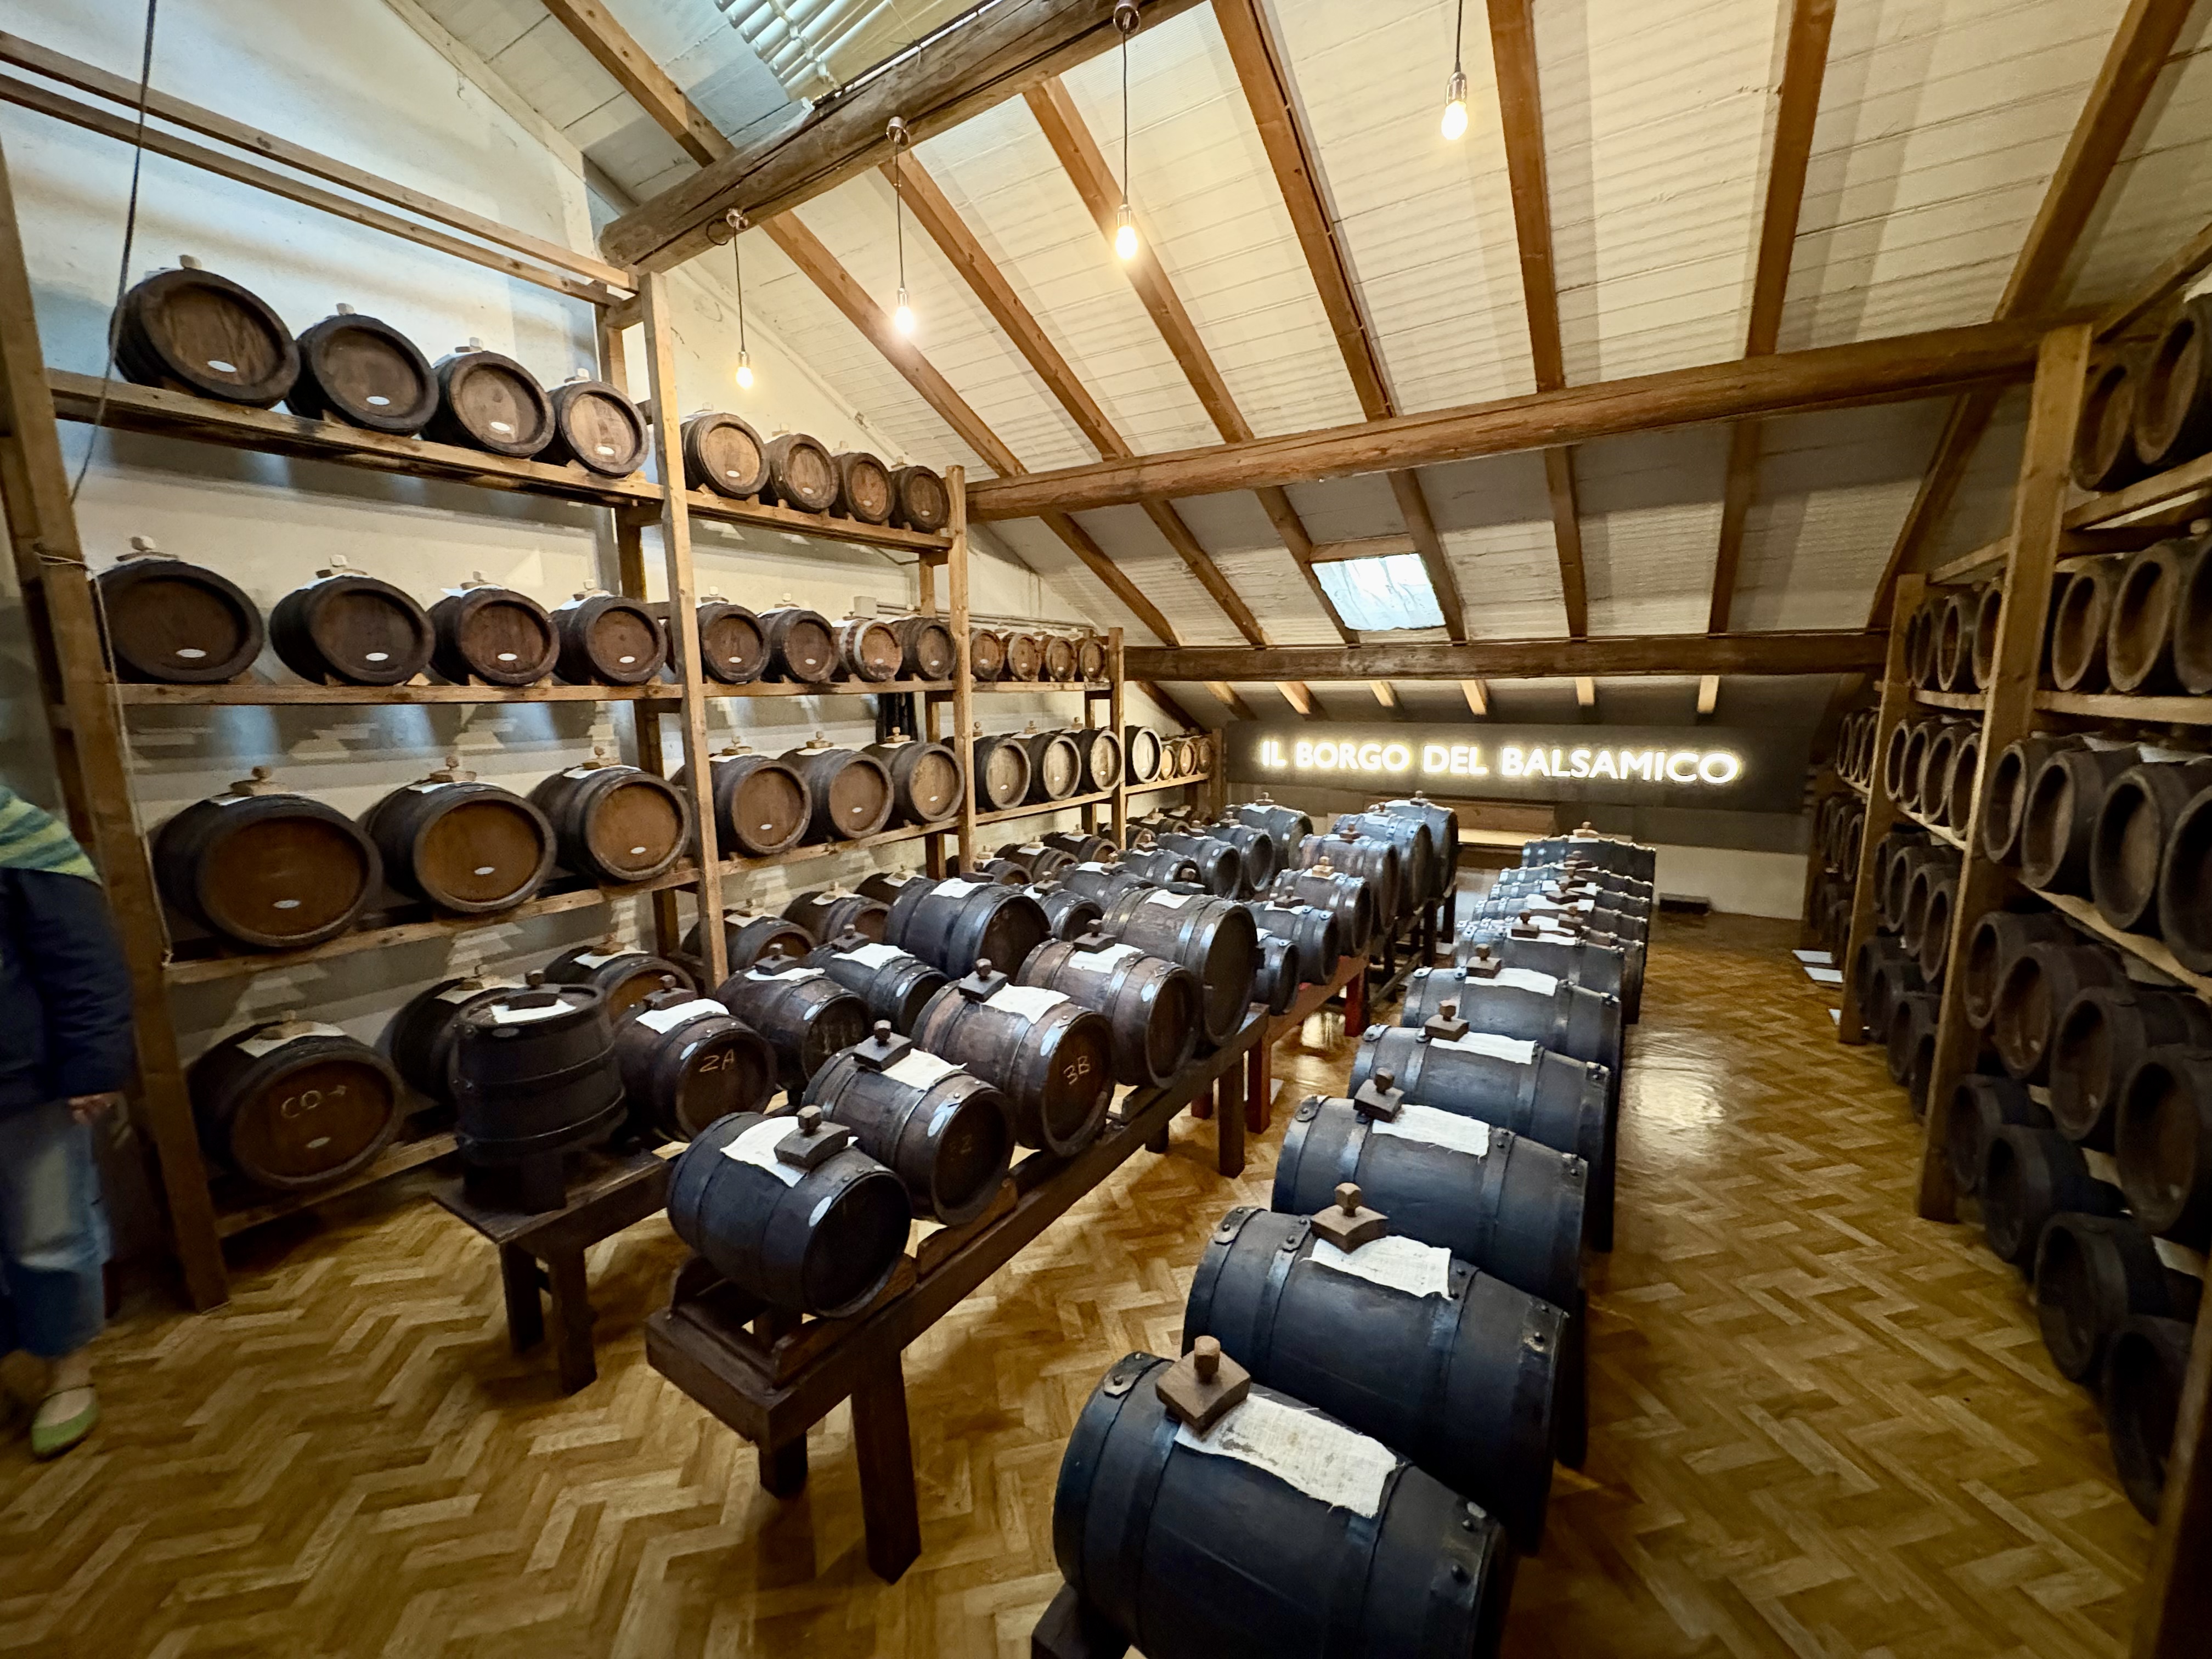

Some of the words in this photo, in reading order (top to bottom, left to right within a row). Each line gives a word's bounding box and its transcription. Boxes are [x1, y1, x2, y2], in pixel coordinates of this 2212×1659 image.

[1262, 740, 1288, 768] IL
[1295, 741, 1410, 772] BORGO
[1423, 744, 1490, 775] DEL
[1500, 746, 1739, 784] BALSAMICO
[698, 1048, 736, 1073] 2A
[1062, 1054, 1092, 1087] 3B
